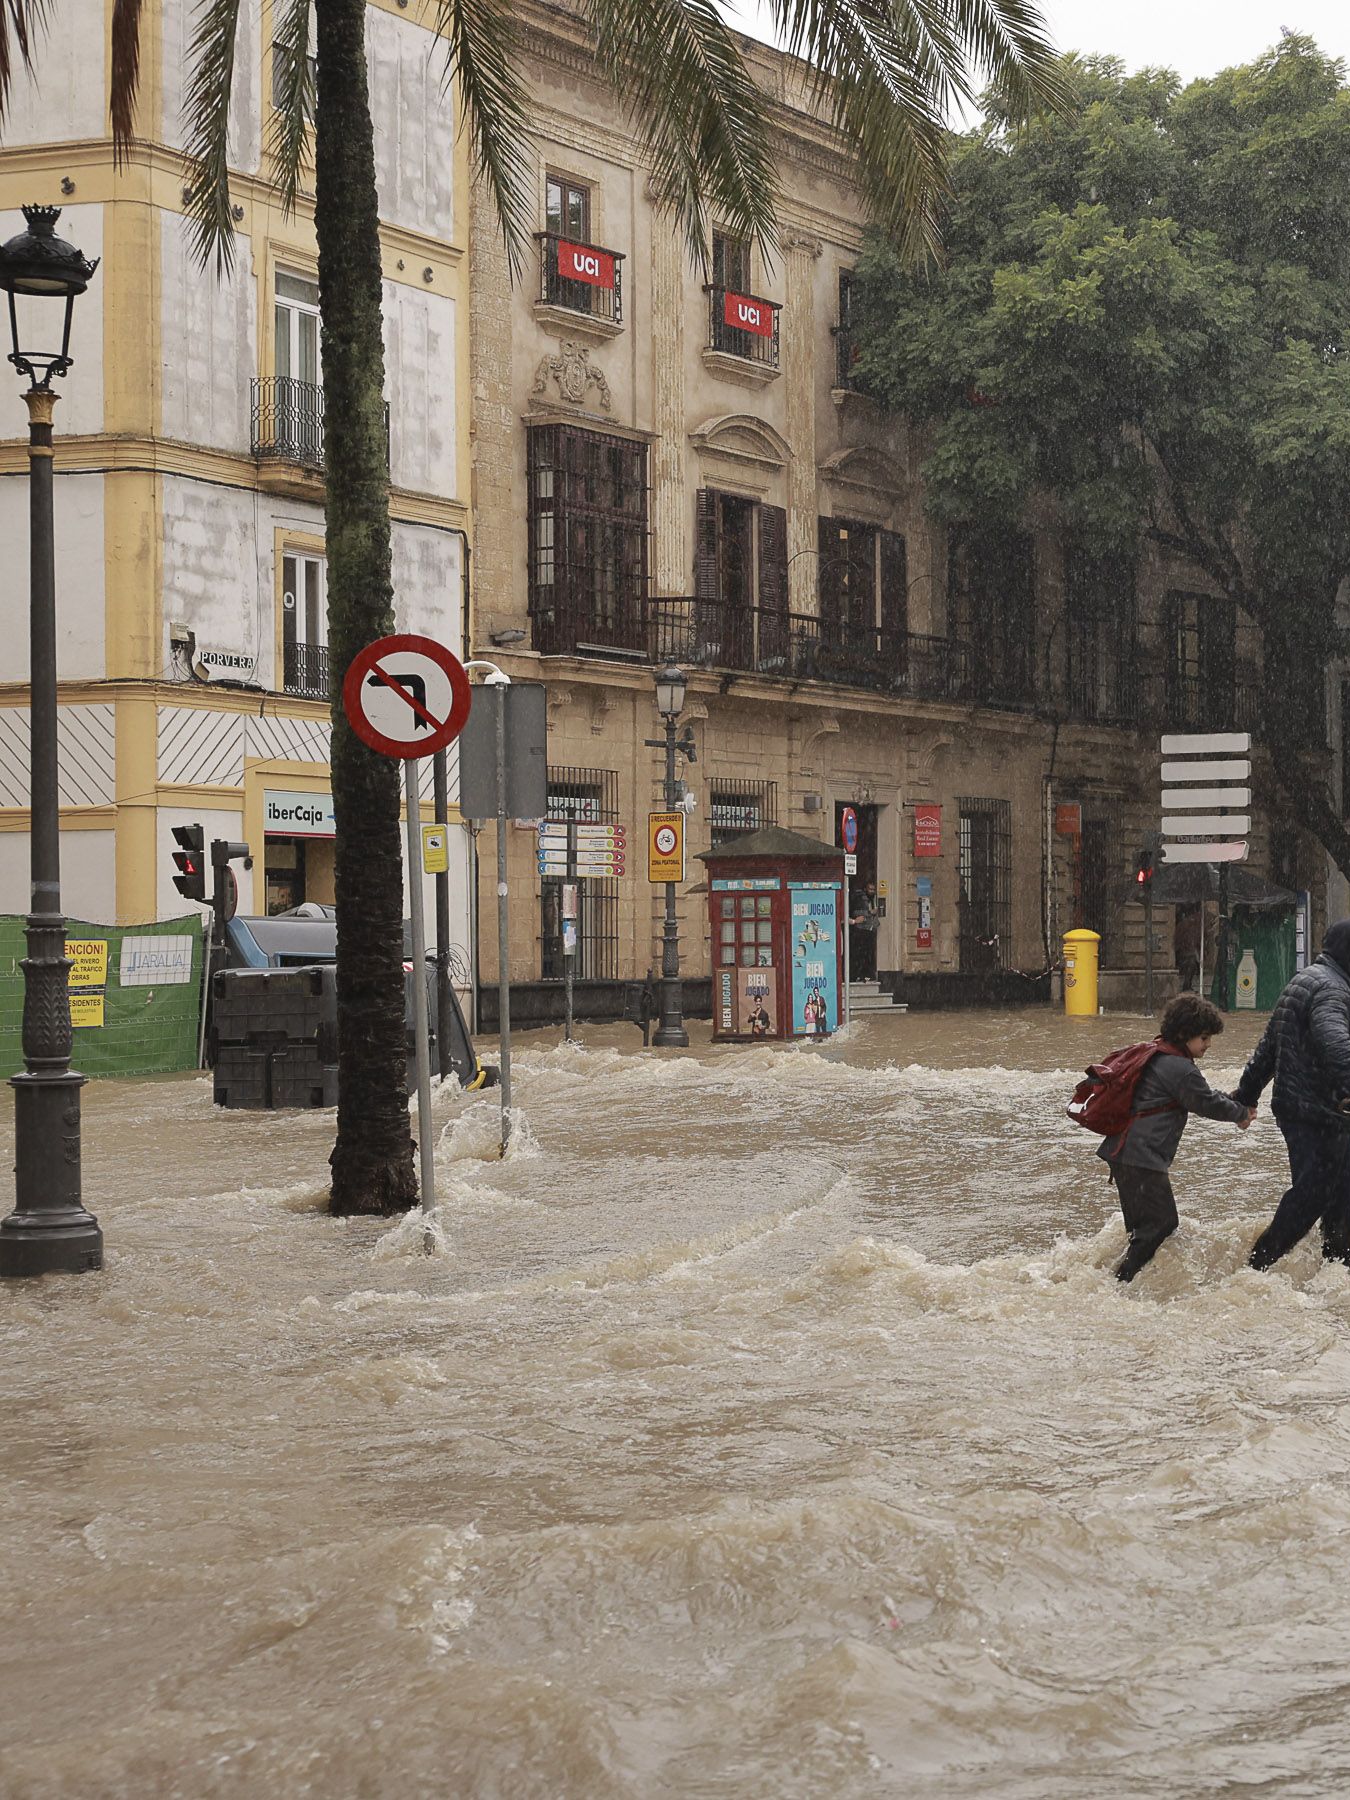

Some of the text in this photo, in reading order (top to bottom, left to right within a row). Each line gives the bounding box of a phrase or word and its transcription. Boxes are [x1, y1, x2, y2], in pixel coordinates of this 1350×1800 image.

[573, 253, 600, 277] UCI
[738, 303, 761, 326] UCI
[201, 651, 255, 670] PORVERA
[268, 802, 323, 826] iberCaja
[793, 903, 834, 916] BIEN JUGADO
[806, 961, 824, 977] BIEN
[747, 973, 767, 986] BIEN
[804, 977, 828, 989] JUGADO
[722, 974, 732, 1005] JUGADO
[745, 986, 770, 996] JUGADO
[722, 1007, 732, 1028] BIEN
